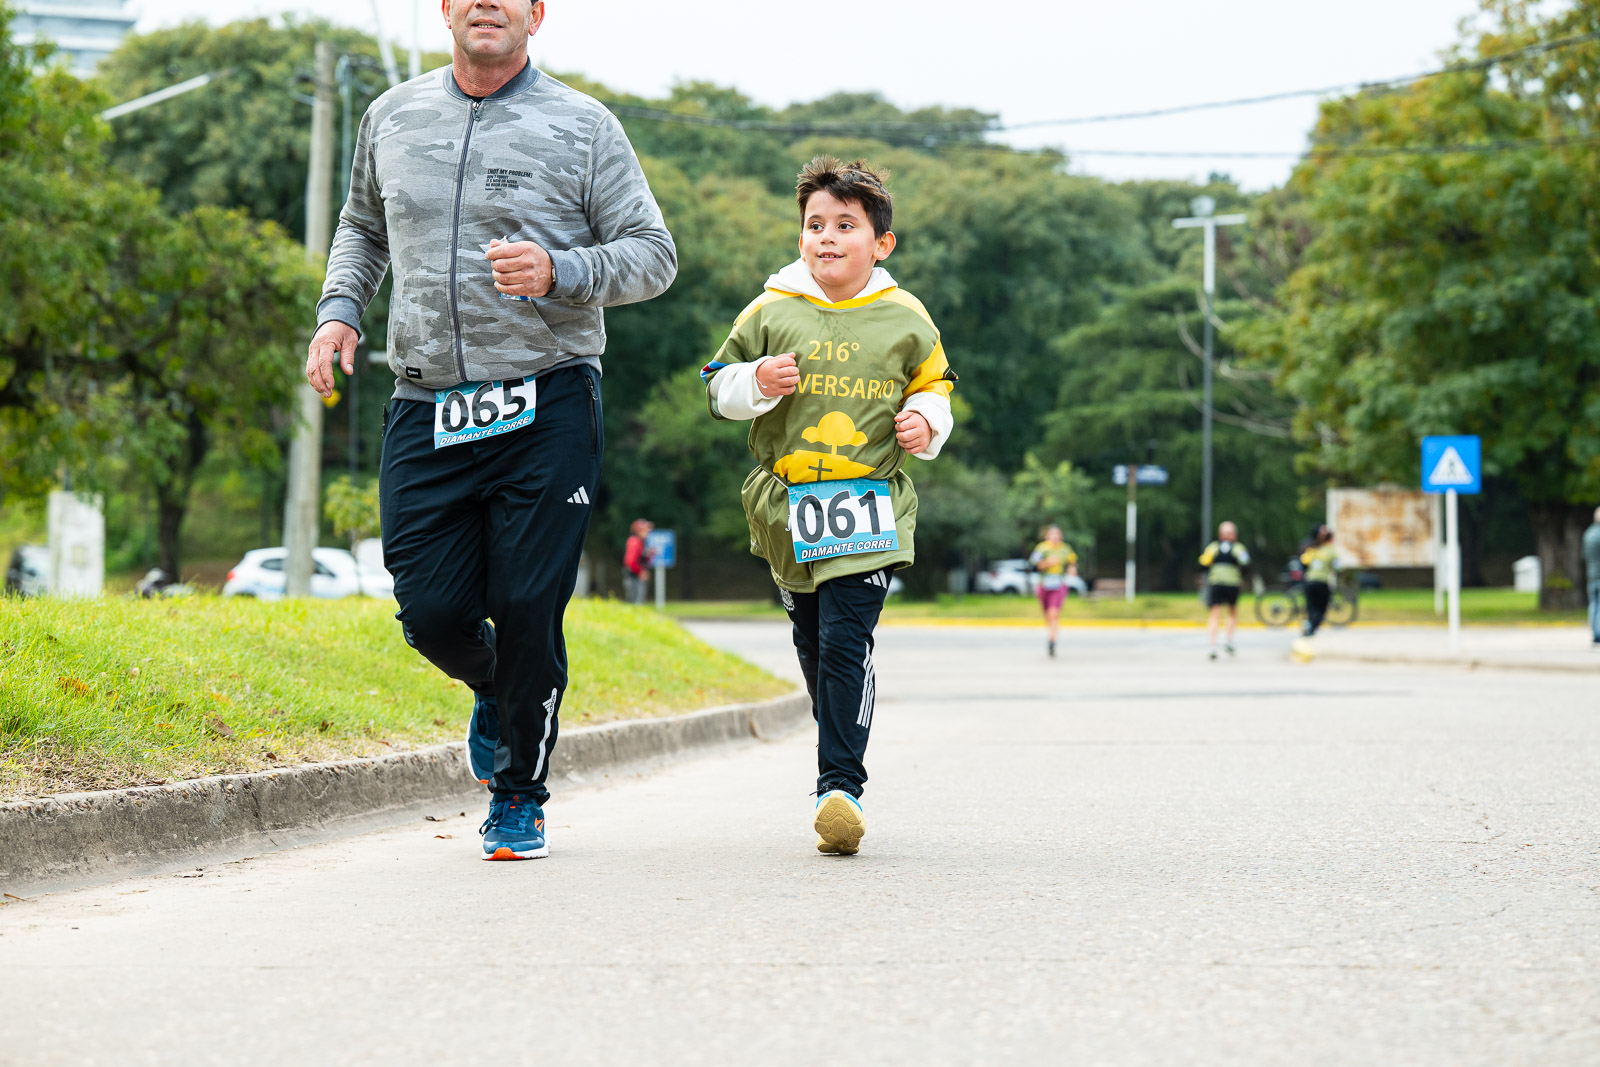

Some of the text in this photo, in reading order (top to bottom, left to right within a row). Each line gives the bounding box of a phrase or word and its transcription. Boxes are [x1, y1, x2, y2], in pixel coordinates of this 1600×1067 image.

[807, 340, 860, 362] 216°
[797, 373, 895, 400] VERSARIO
[441, 377, 527, 433] 065
[440, 415, 531, 446] DIAMANTE CORRE
[796, 490, 881, 544] 061
[800, 538, 894, 560] DIAMANTE CORRE
